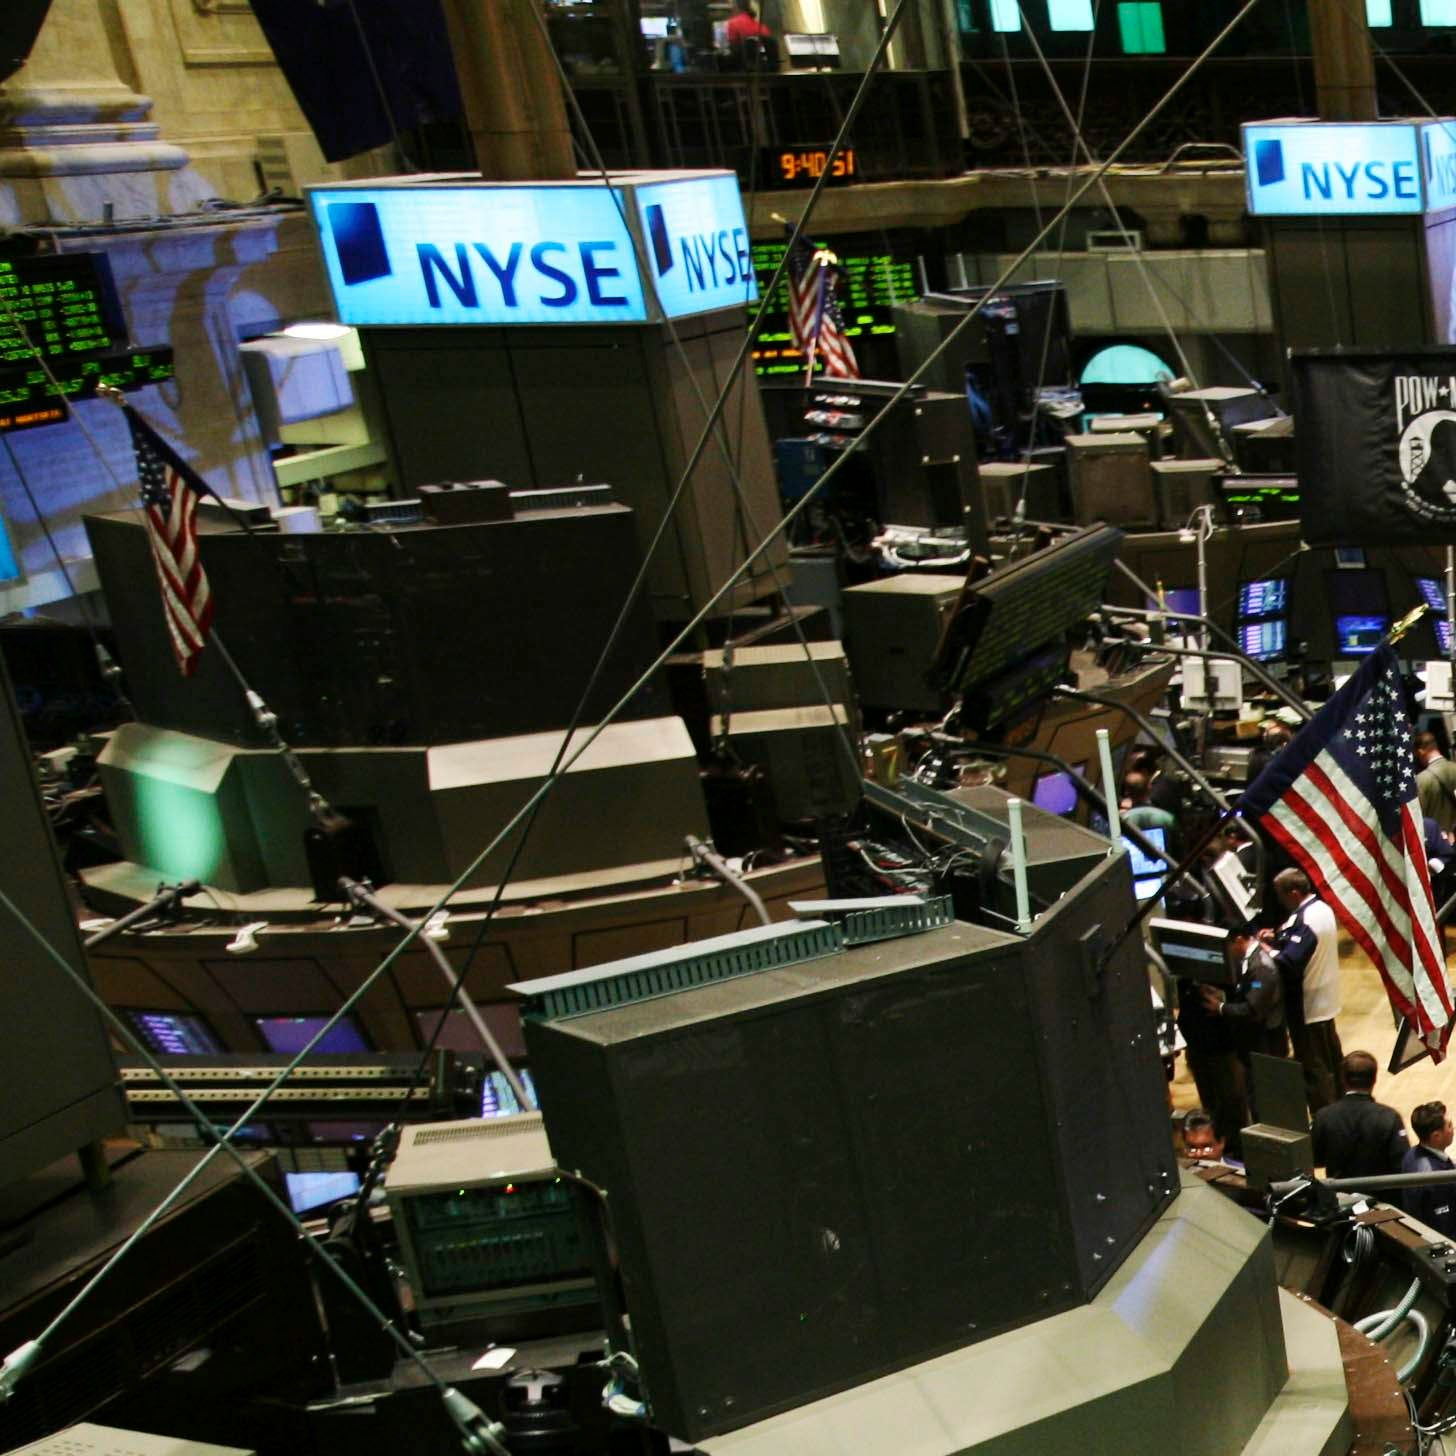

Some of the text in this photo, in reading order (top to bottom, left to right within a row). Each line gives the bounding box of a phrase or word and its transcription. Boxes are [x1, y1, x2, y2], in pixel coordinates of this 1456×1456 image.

[1303, 161, 1417, 200] NYSE
[417, 240, 628, 309] NYSE
[681, 228, 752, 293] NYSE
[1394, 376, 1439, 434] POW
